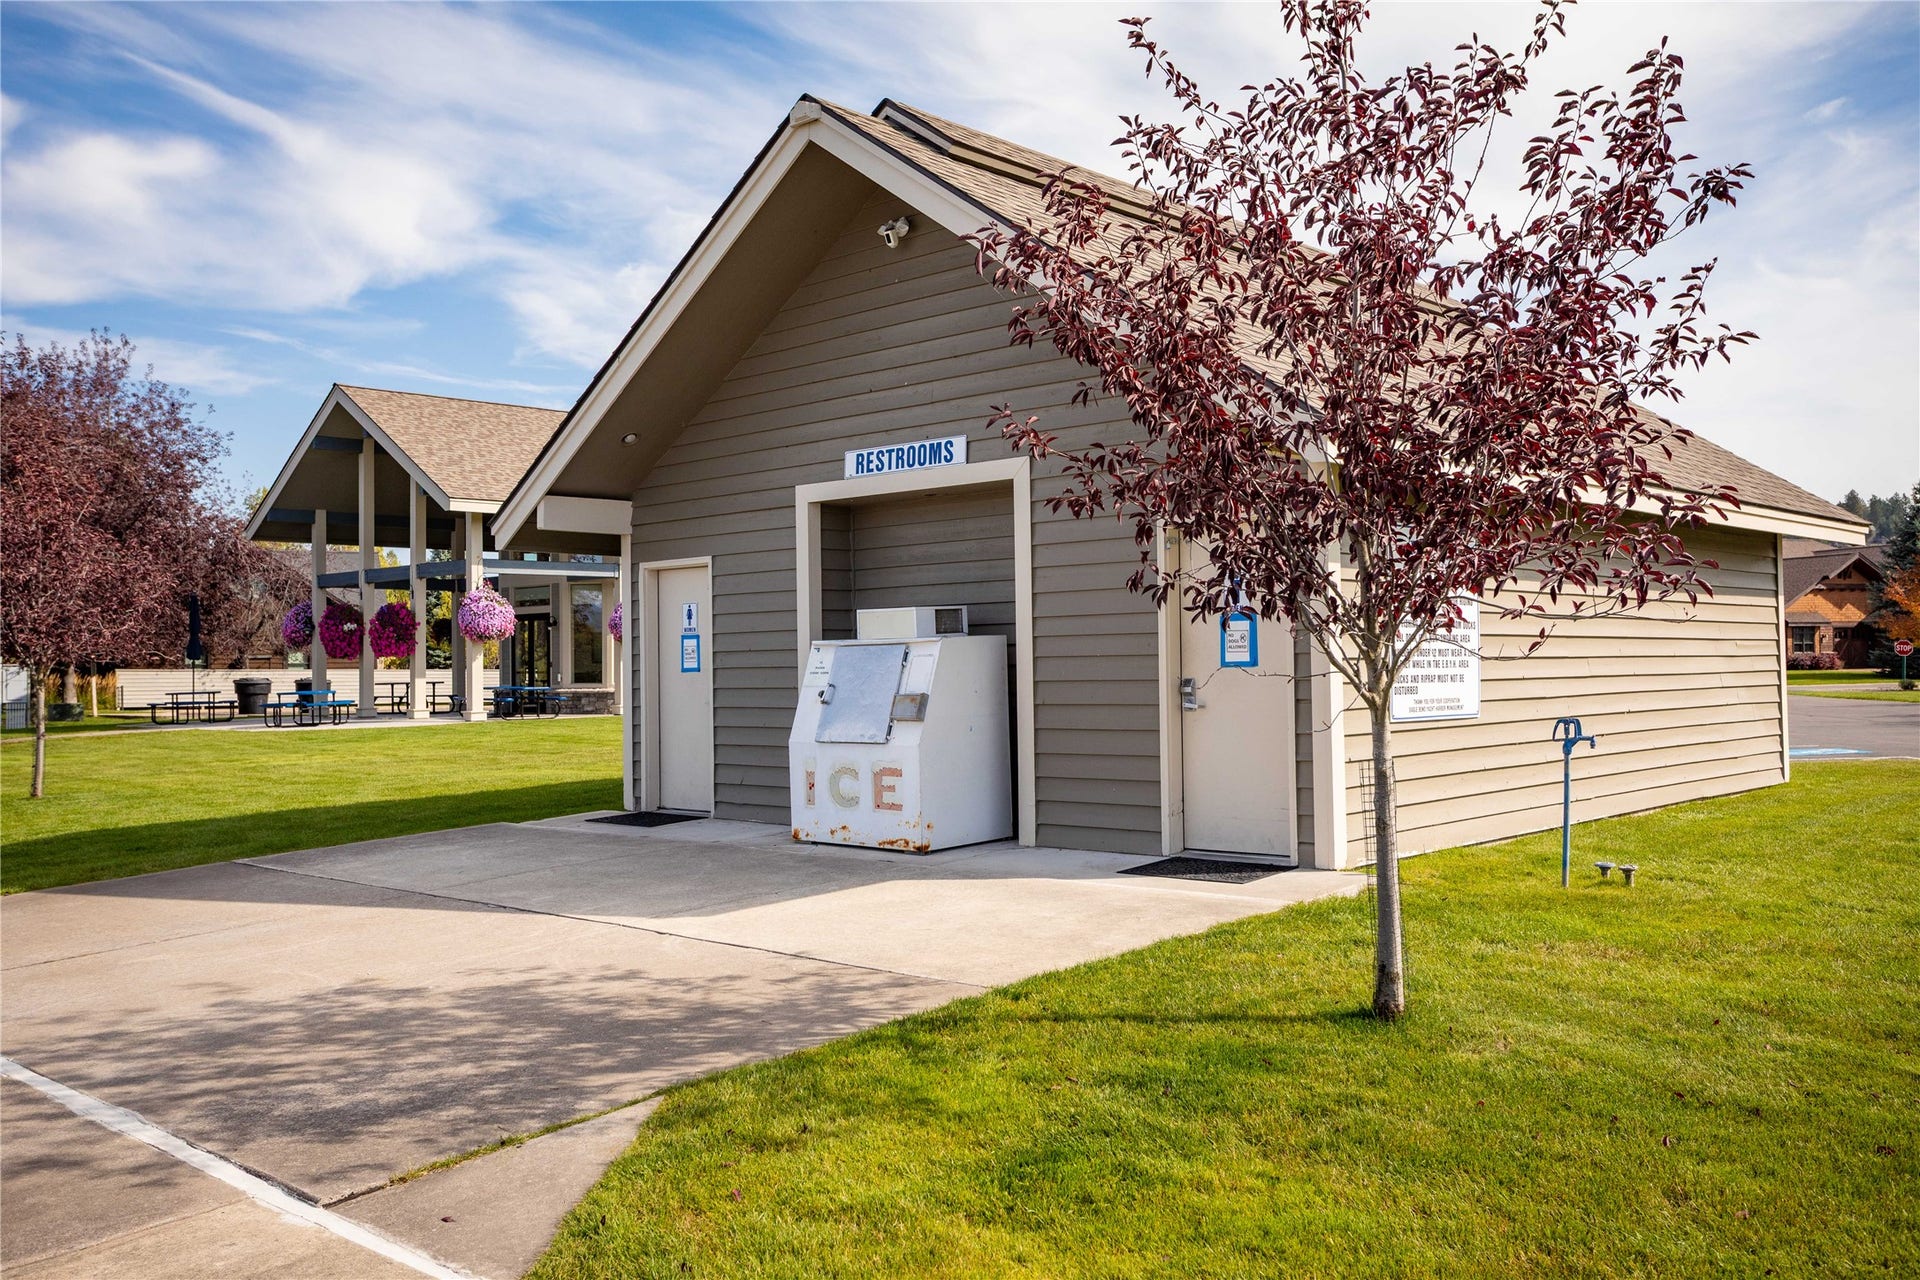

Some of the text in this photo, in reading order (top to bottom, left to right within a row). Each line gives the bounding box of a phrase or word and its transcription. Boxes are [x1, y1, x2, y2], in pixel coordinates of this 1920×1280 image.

[855, 439, 954, 474] RESTROOMS
[1460, 634, 1470, 643] AREA
[1417, 648, 1430, 658] UNDER
[1438, 648, 1450, 657] MUST
[1451, 648, 1463, 657] WEAR
[1896, 644, 1912, 652] STOP
[1412, 660, 1426, 669] WHILE
[1426, 660, 1432, 668] IN
[1458, 660, 1469, 668] AREA
[1410, 674, 1420, 684] AND
[1421, 674, 1436, 683] RIPRAP
[1437, 674, 1449, 683] MUST
[1450, 674, 1458, 683] NOT
[1459, 673, 1465, 683] BE
[1394, 685, 1418, 695] DISTURBED
[804, 765, 903, 811] ICE
